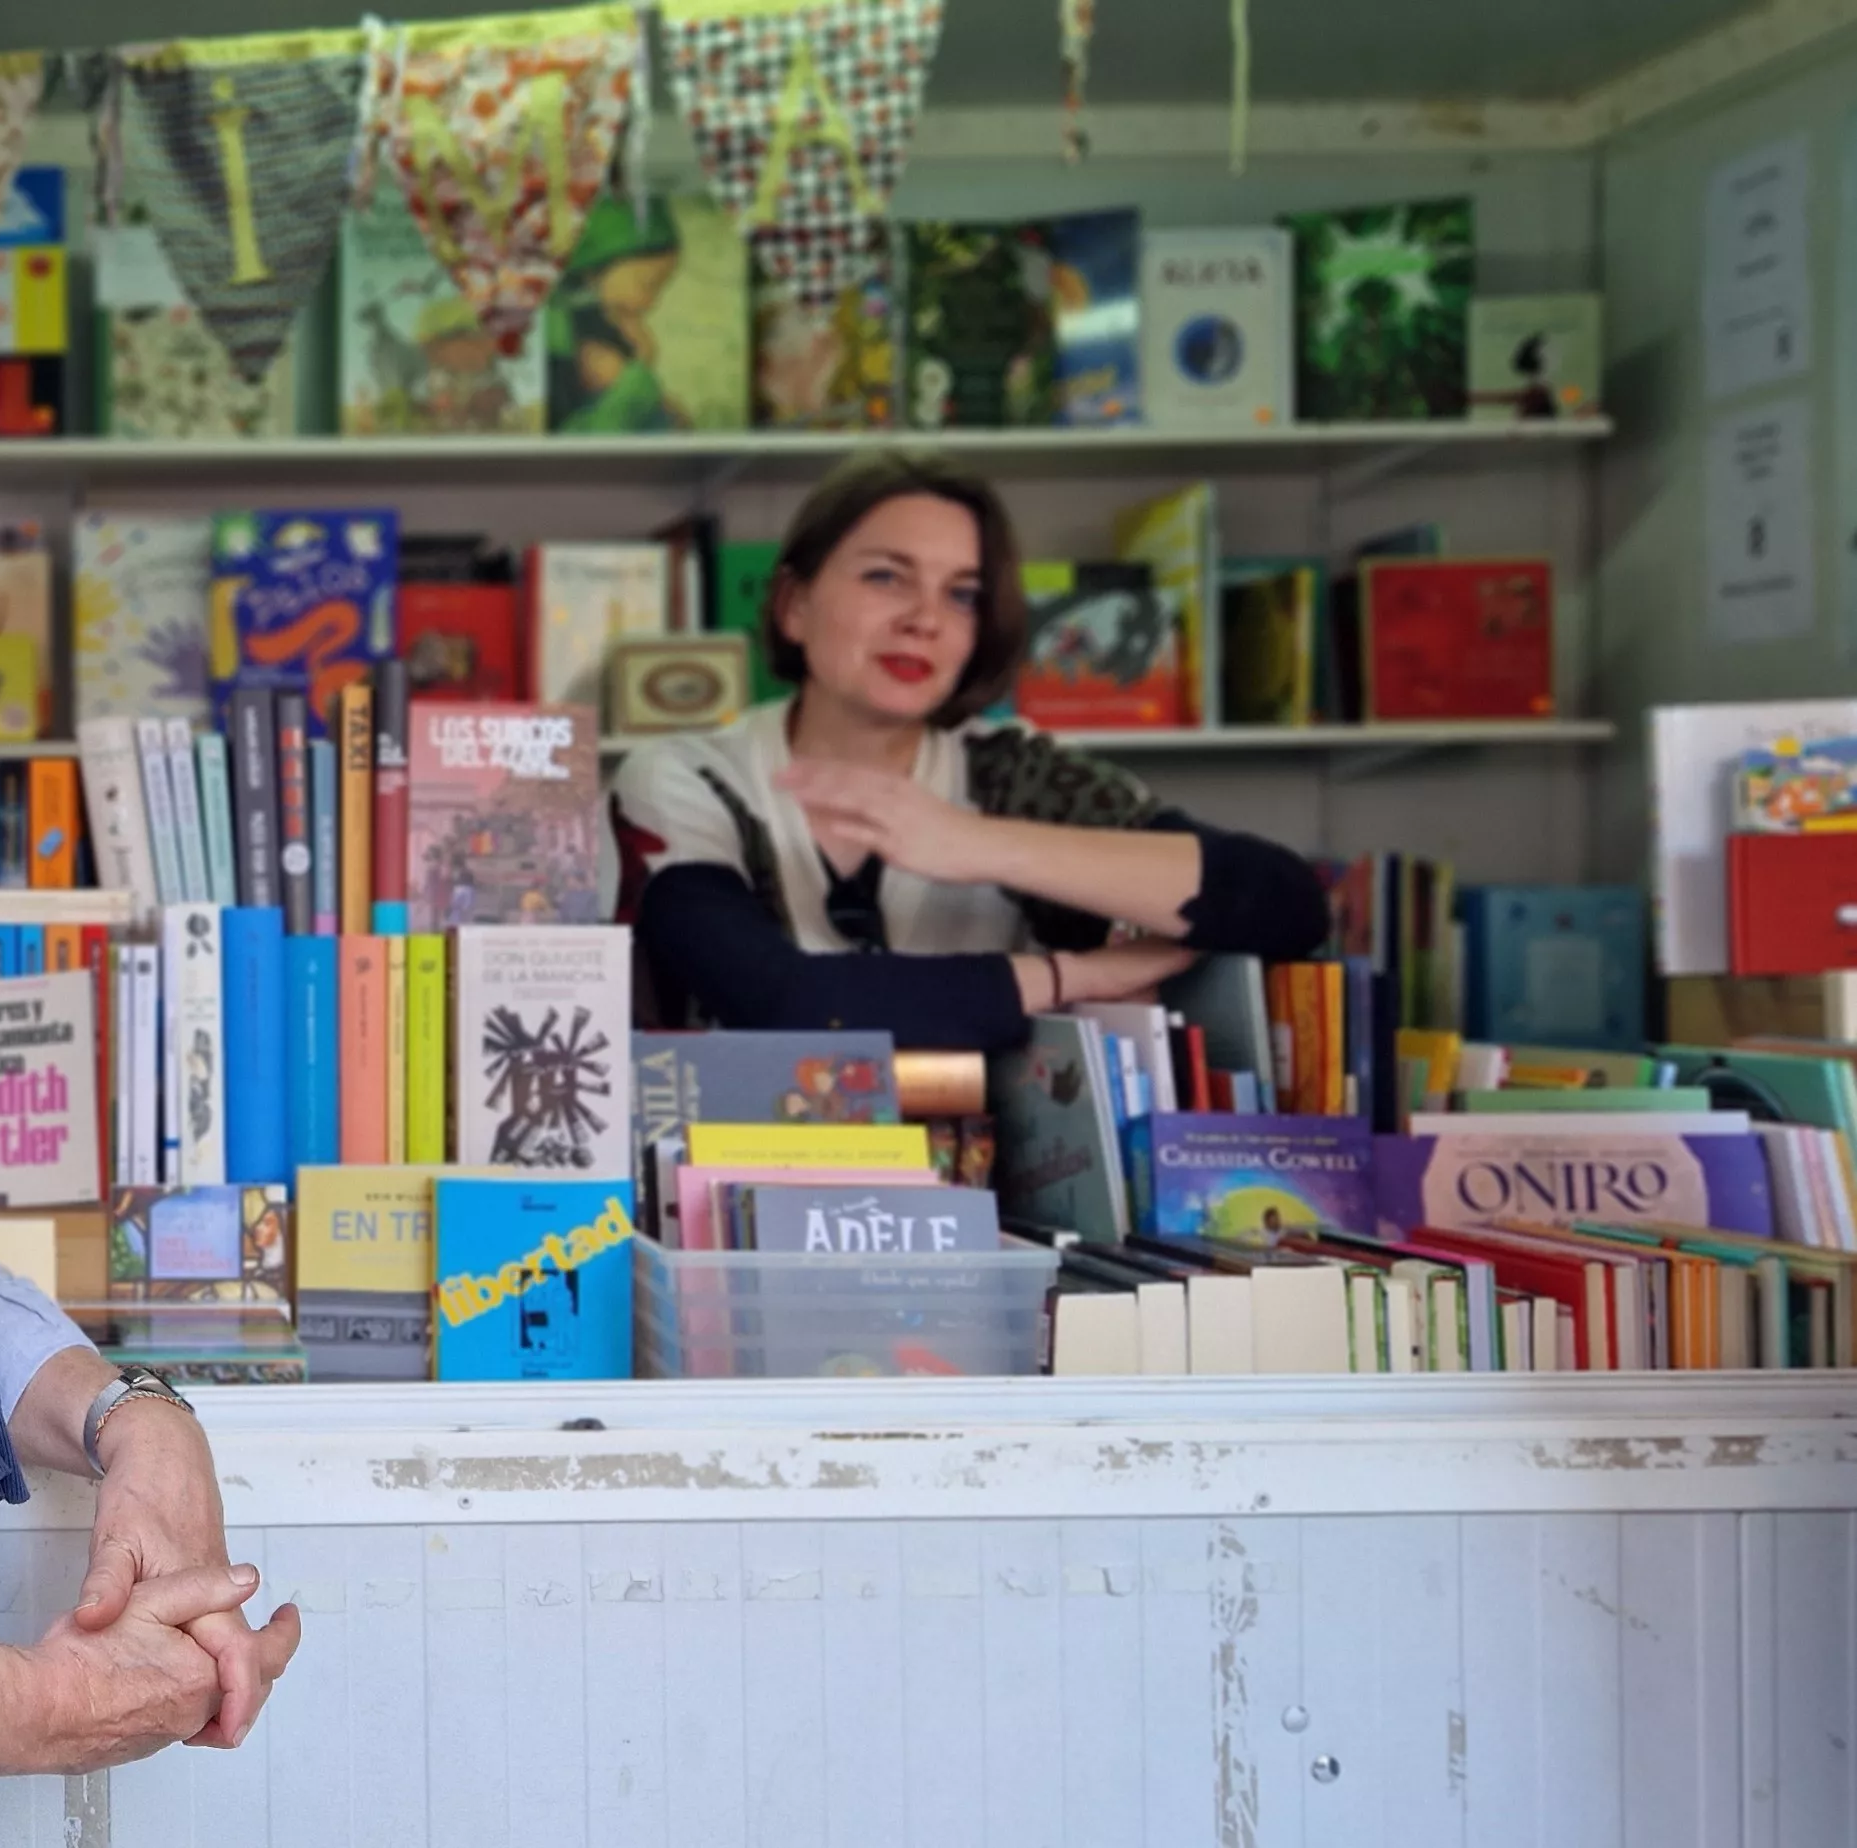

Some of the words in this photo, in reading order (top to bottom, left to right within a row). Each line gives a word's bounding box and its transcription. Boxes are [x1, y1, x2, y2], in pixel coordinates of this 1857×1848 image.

[348, 704, 369, 771] TAXI
[1159, 1144, 1264, 1169] CRESSIDA
[1267, 1147, 1358, 1172] COWELL
[1456, 1160, 1668, 1214] ONIRO
[331, 1209, 378, 1241] EN
[438, 1196, 636, 1328] libertad
